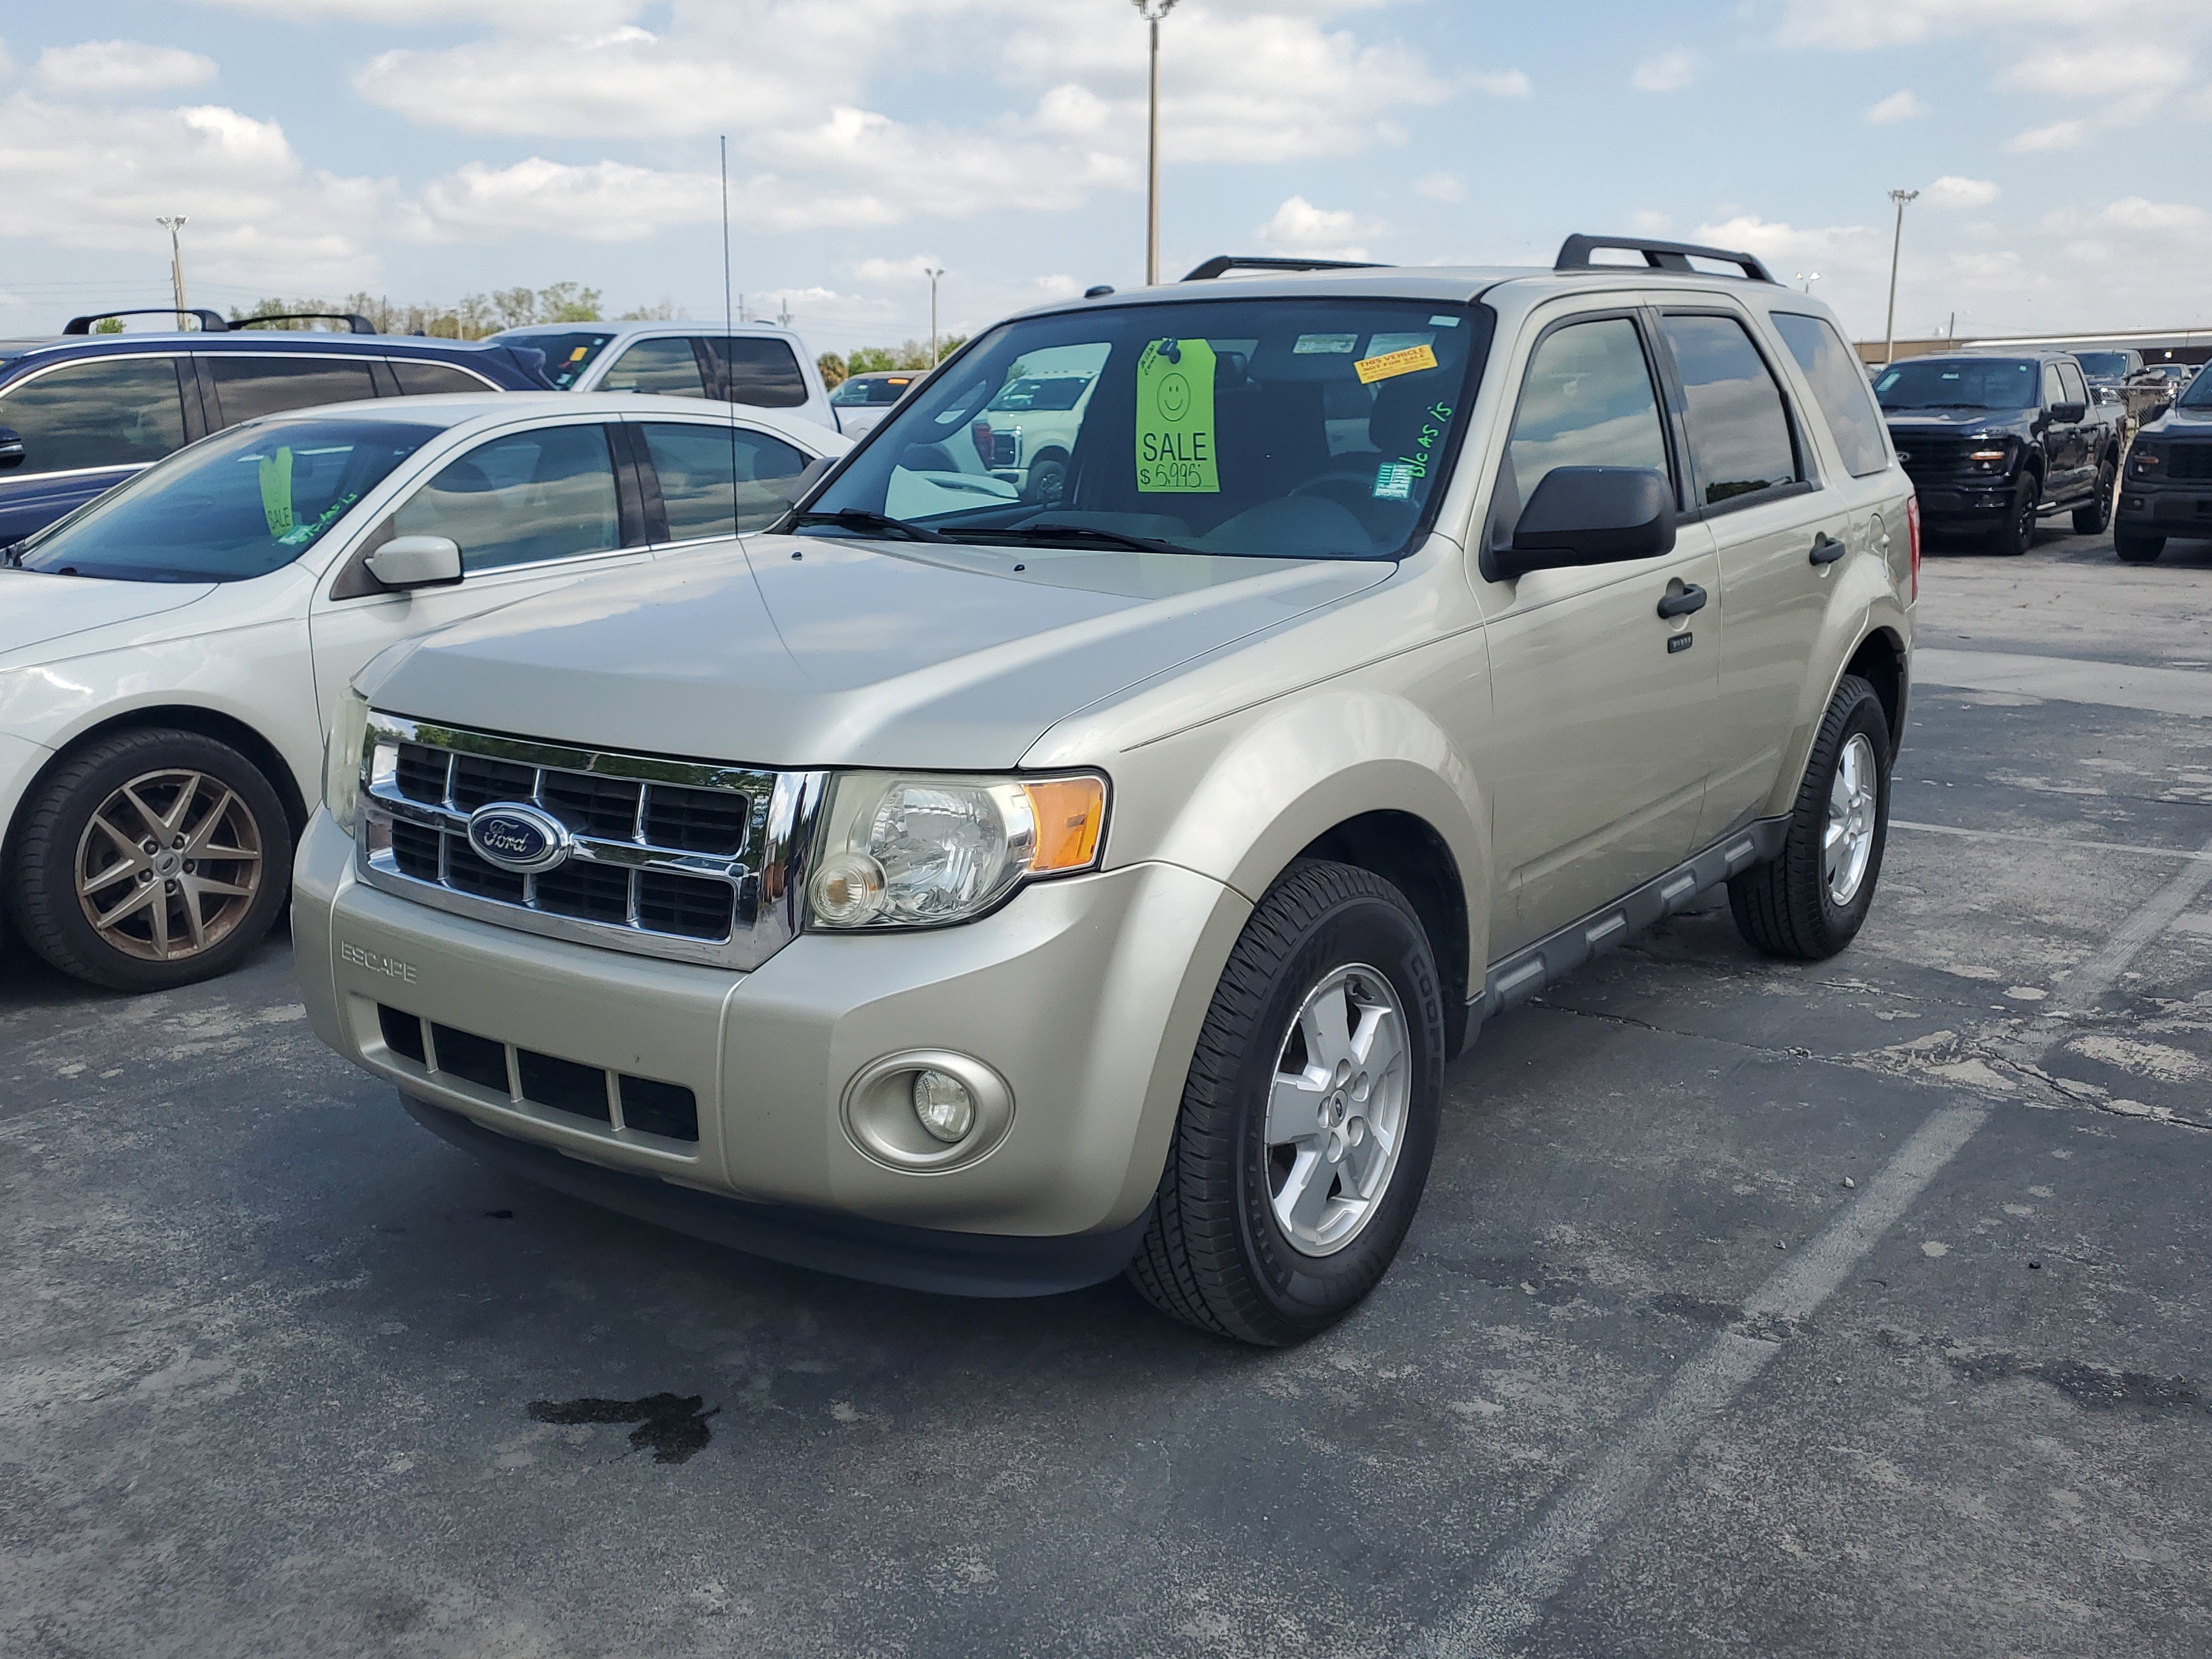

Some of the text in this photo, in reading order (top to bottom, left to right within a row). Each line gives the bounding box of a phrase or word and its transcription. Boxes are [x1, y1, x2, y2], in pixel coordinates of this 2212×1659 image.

[1143, 432, 1207, 462] SALE
[484, 819, 529, 853] Ford
[341, 940, 416, 984] ESCAPE
